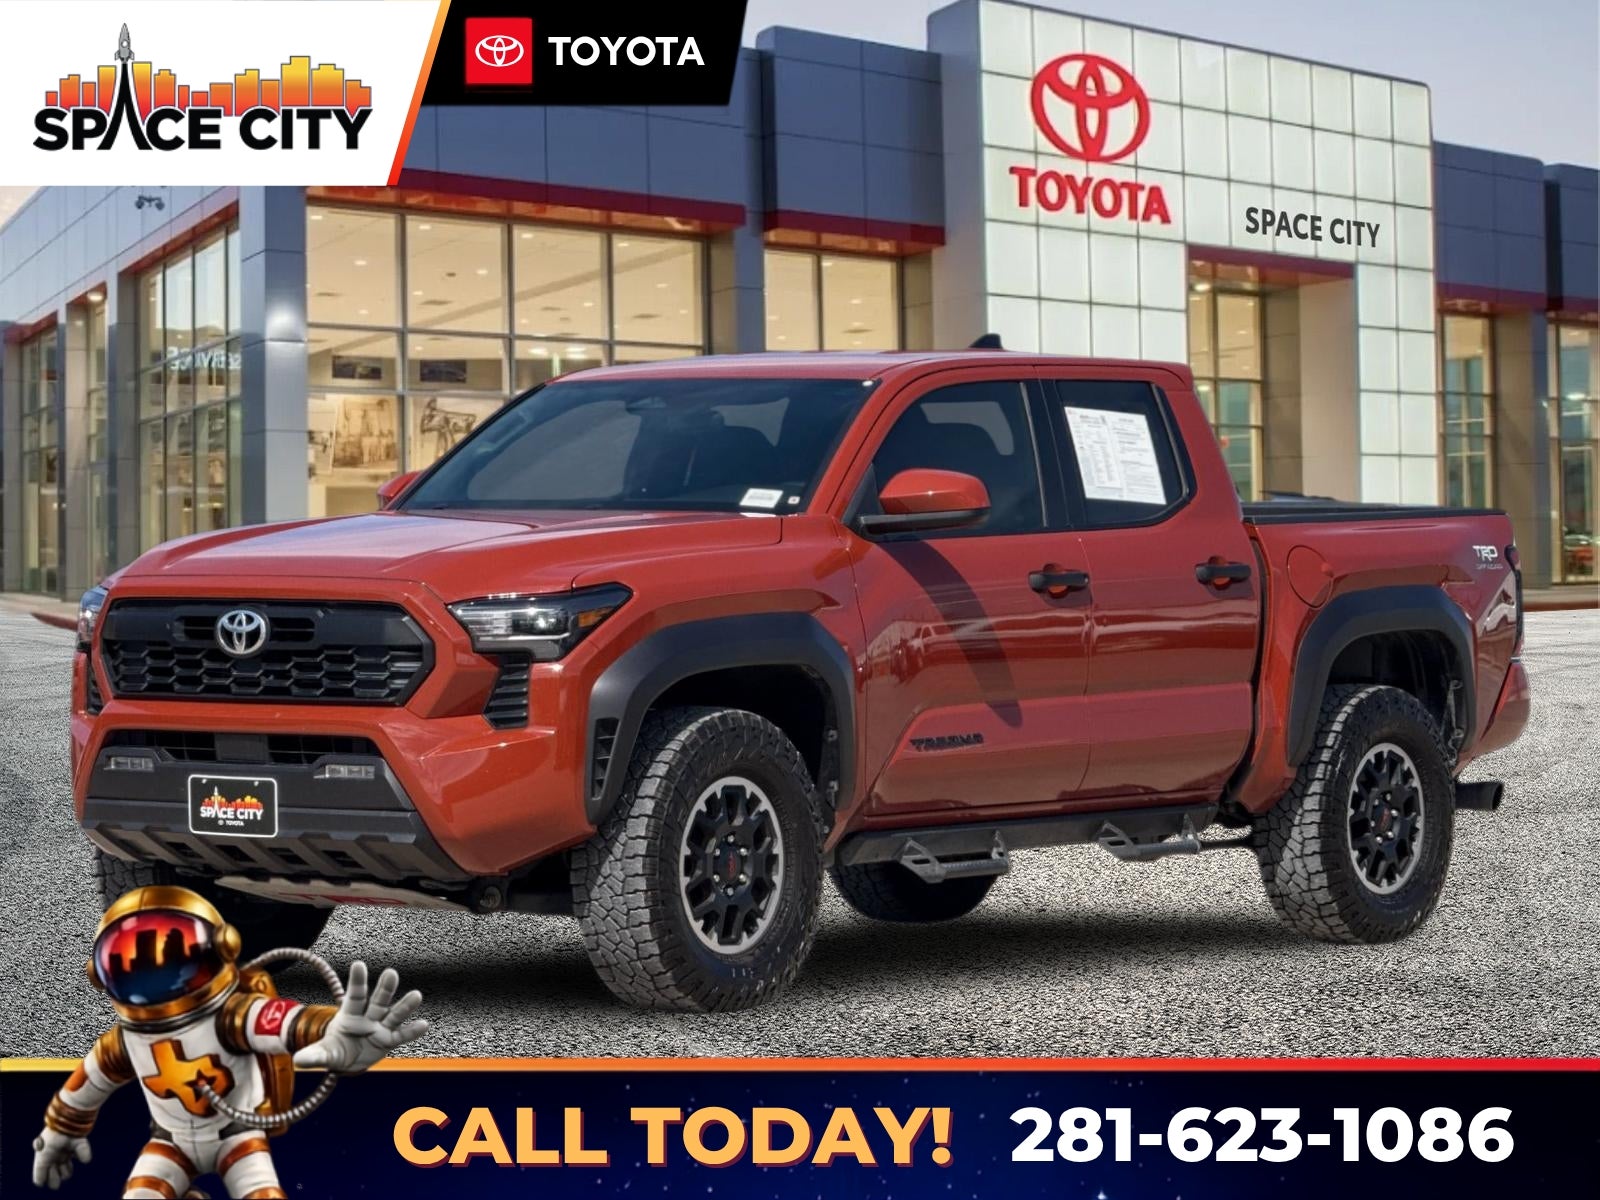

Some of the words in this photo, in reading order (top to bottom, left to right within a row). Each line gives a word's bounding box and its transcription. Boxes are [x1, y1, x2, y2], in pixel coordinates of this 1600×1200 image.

[1009, 166, 1171, 224] TOYOTA
[1245, 206, 1323, 242] SPACE
[1330, 217, 1381, 248] CITY
[1472, 545, 1498, 561] TRD
[200, 806, 235, 819] SPACE
[236, 808, 264, 821] CITY
